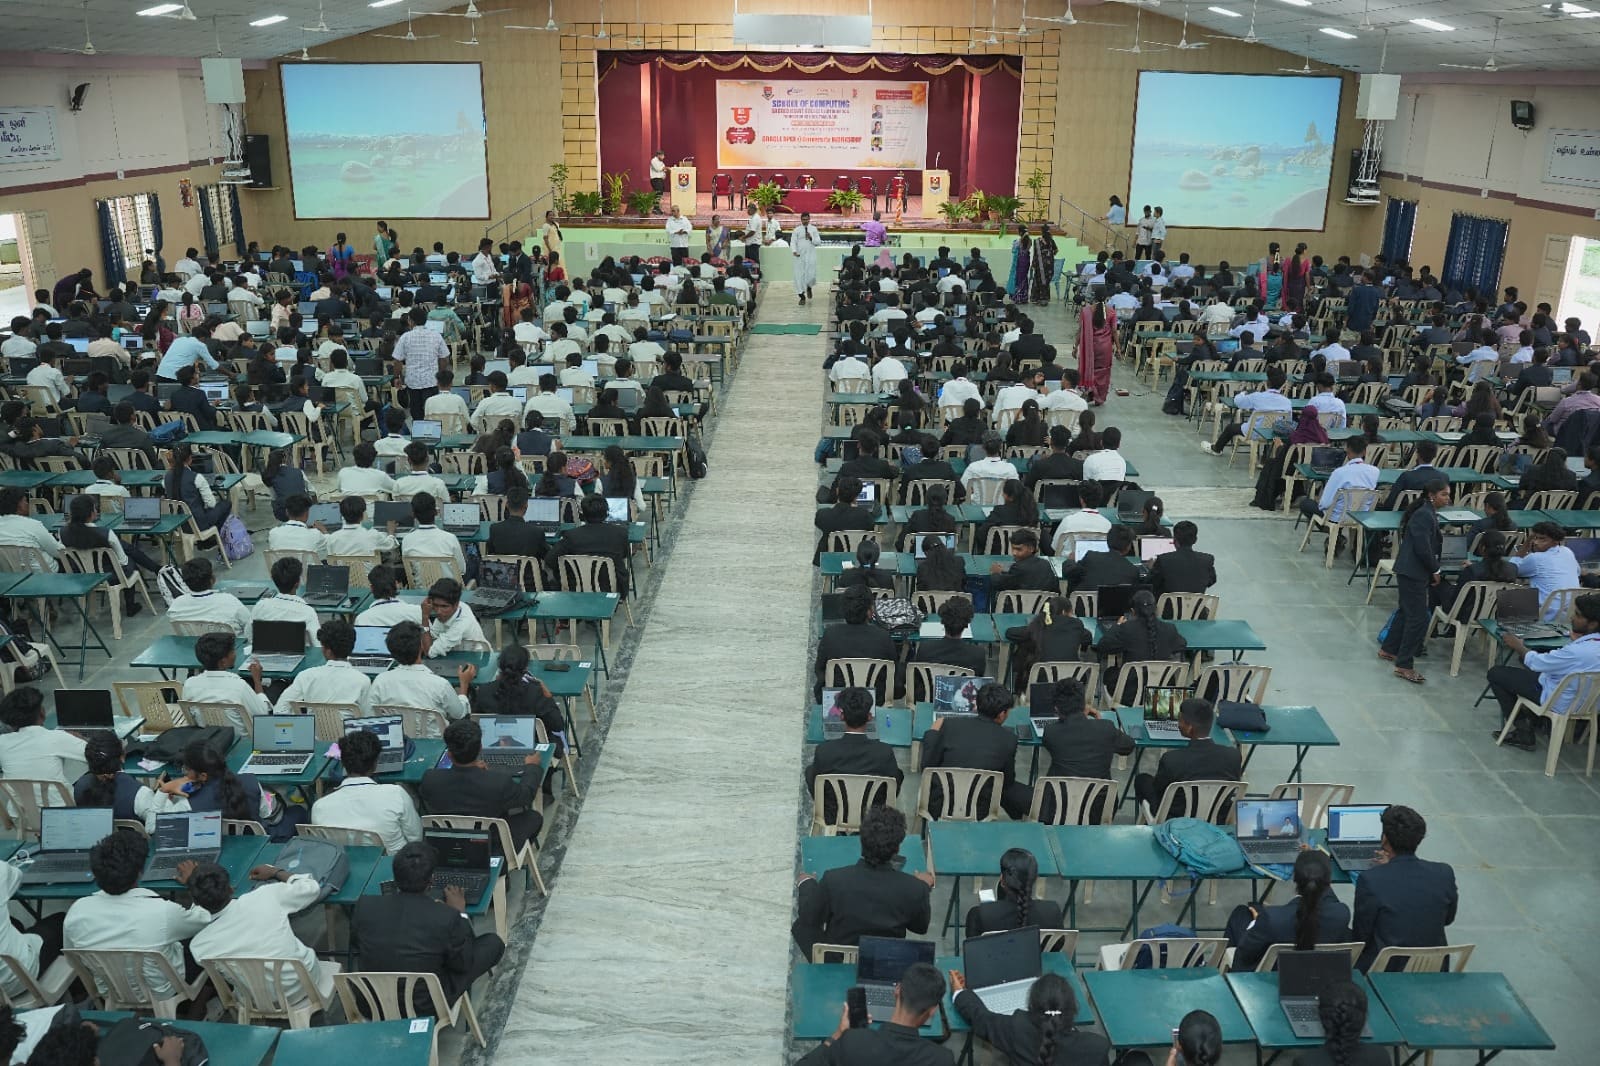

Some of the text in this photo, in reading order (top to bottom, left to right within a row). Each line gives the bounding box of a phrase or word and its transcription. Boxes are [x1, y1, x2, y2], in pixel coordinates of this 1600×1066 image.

[771, 99, 850, 108] SCHOOL OF COMPUTING
